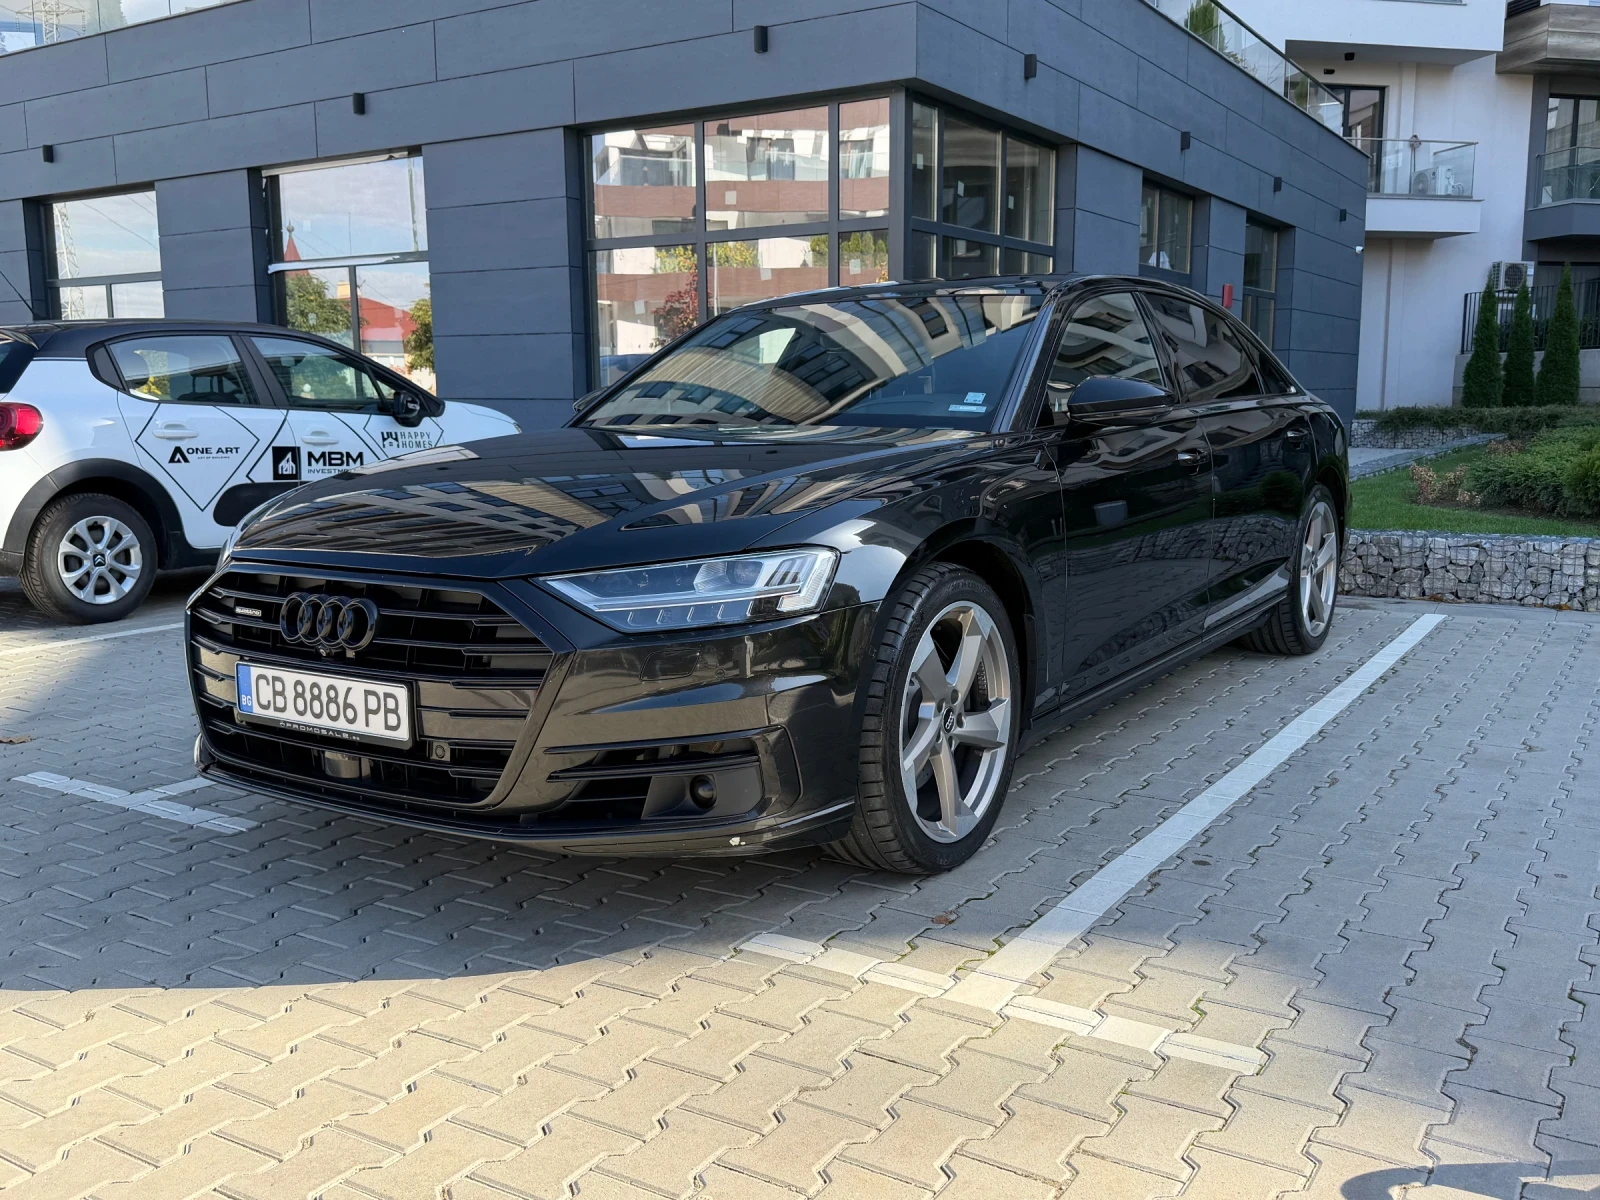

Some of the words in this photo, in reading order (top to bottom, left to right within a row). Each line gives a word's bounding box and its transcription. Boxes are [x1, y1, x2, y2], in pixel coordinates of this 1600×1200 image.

[400, 431, 431, 440] HAPPY
[401, 440, 433, 449] HOMES
[186, 447, 213, 455] ONE
[215, 446, 241, 455] ART
[307, 451, 365, 467] MBM
[241, 694, 252, 706] BG
[255, 673, 288, 713] CB
[293, 679, 358, 725] 8886
[363, 688, 401, 732] PB
